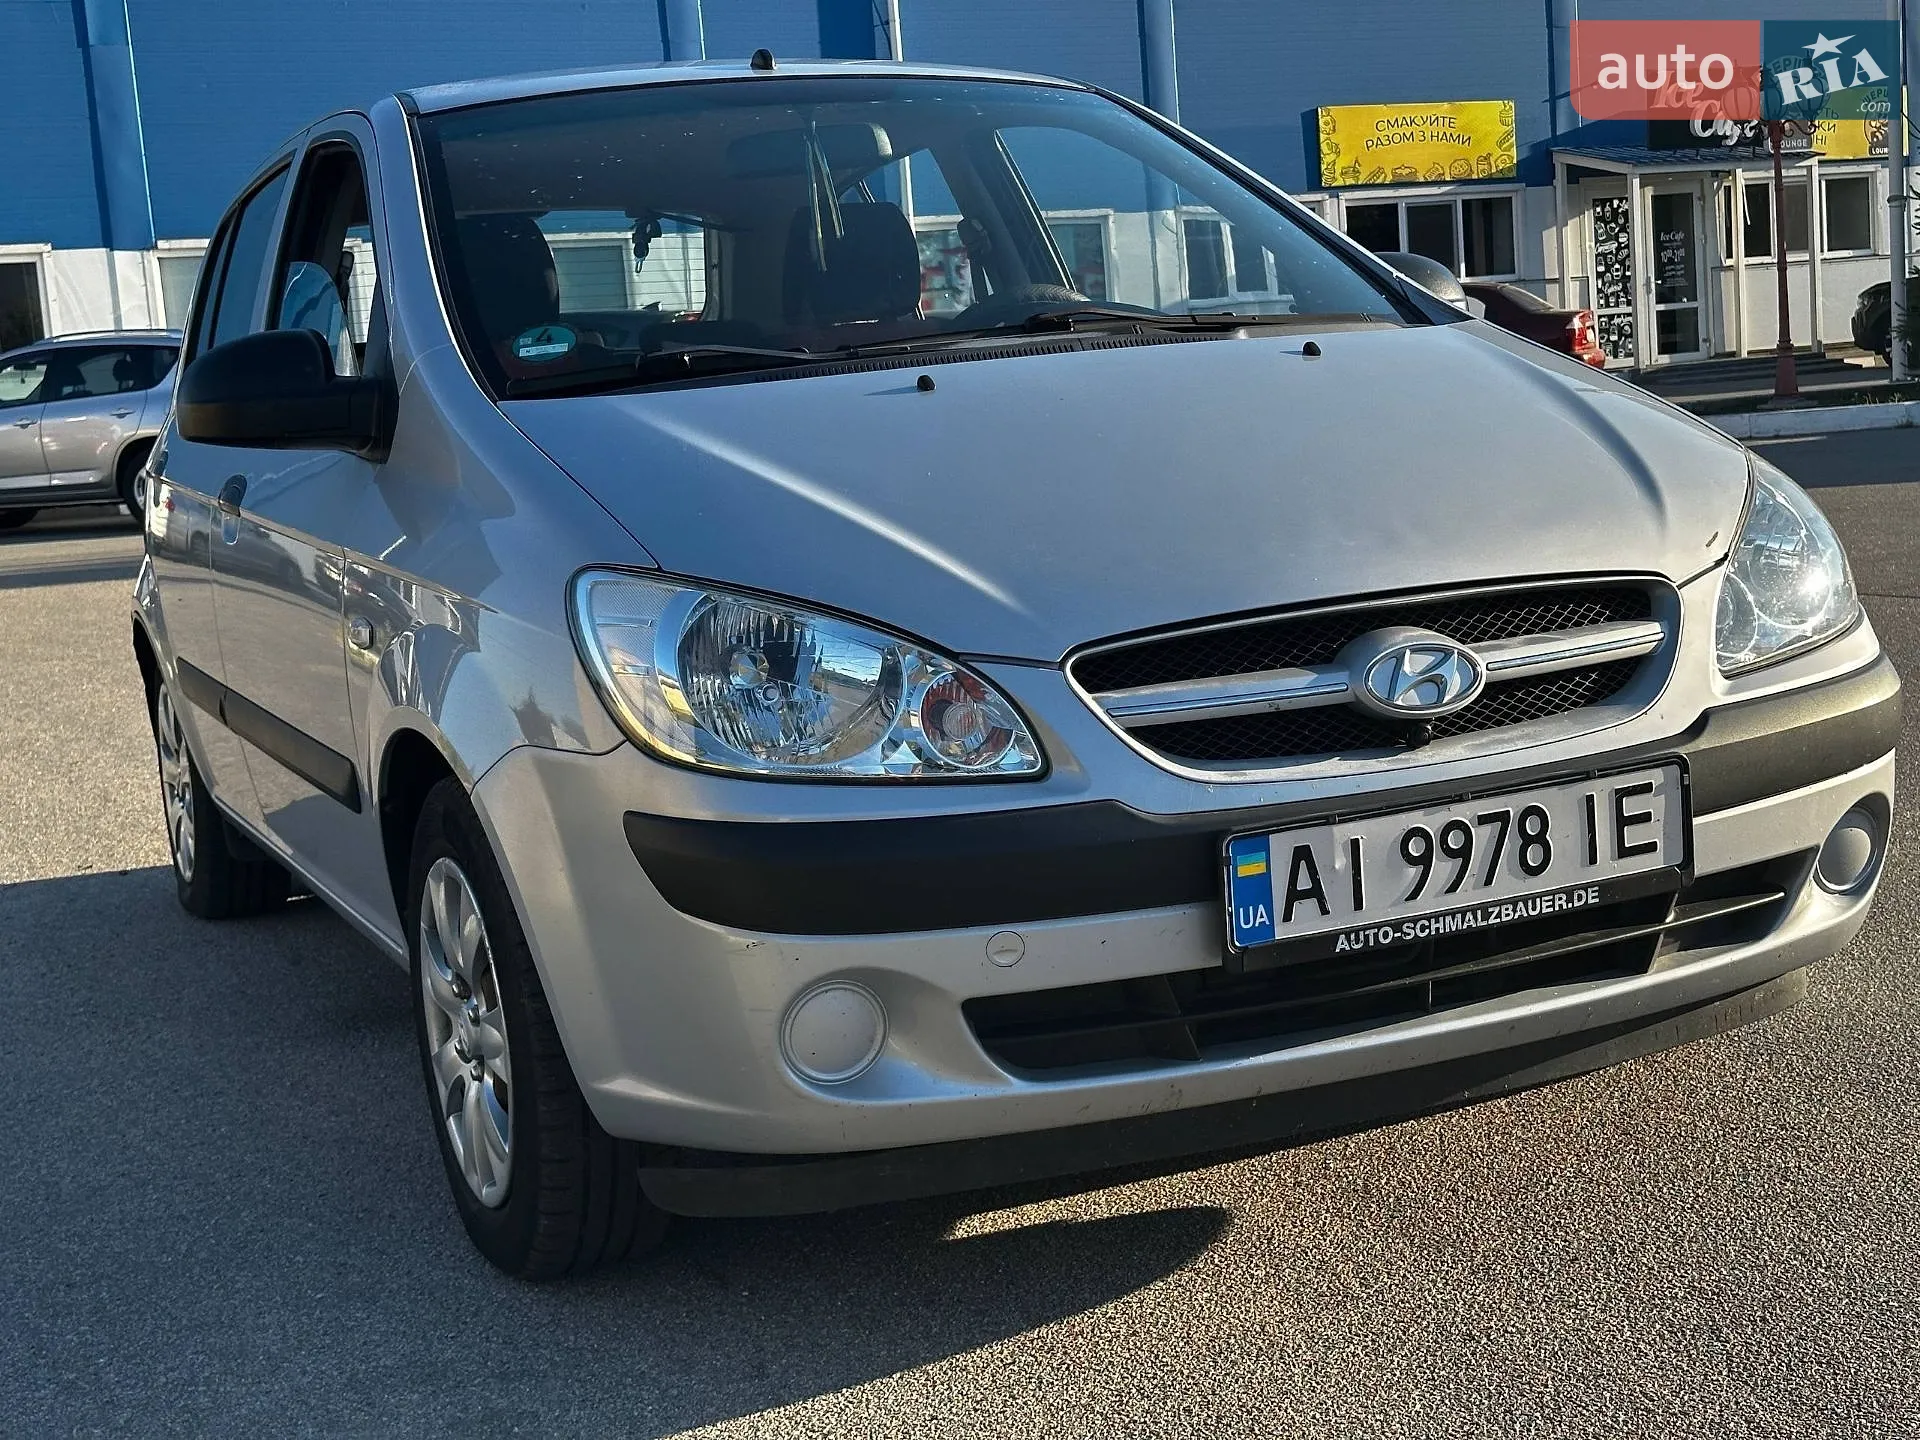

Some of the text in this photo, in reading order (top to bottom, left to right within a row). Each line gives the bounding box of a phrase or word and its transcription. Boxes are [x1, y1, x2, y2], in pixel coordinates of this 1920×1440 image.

[1375, 113, 1457, 132] СМАКУЙТЕ
[1365, 131, 1415, 151] РАЗОМ
[1430, 130, 1472, 147] НАМИ
[1775, 139, 1808, 148] OUNGE
[535, 327, 553, 344] 4
[1282, 780, 1659, 923] AI 9978 IE
[1239, 903, 1271, 929] UA
[1335, 886, 1600, 953] AUTO-SCHMALZBAUER.DE
